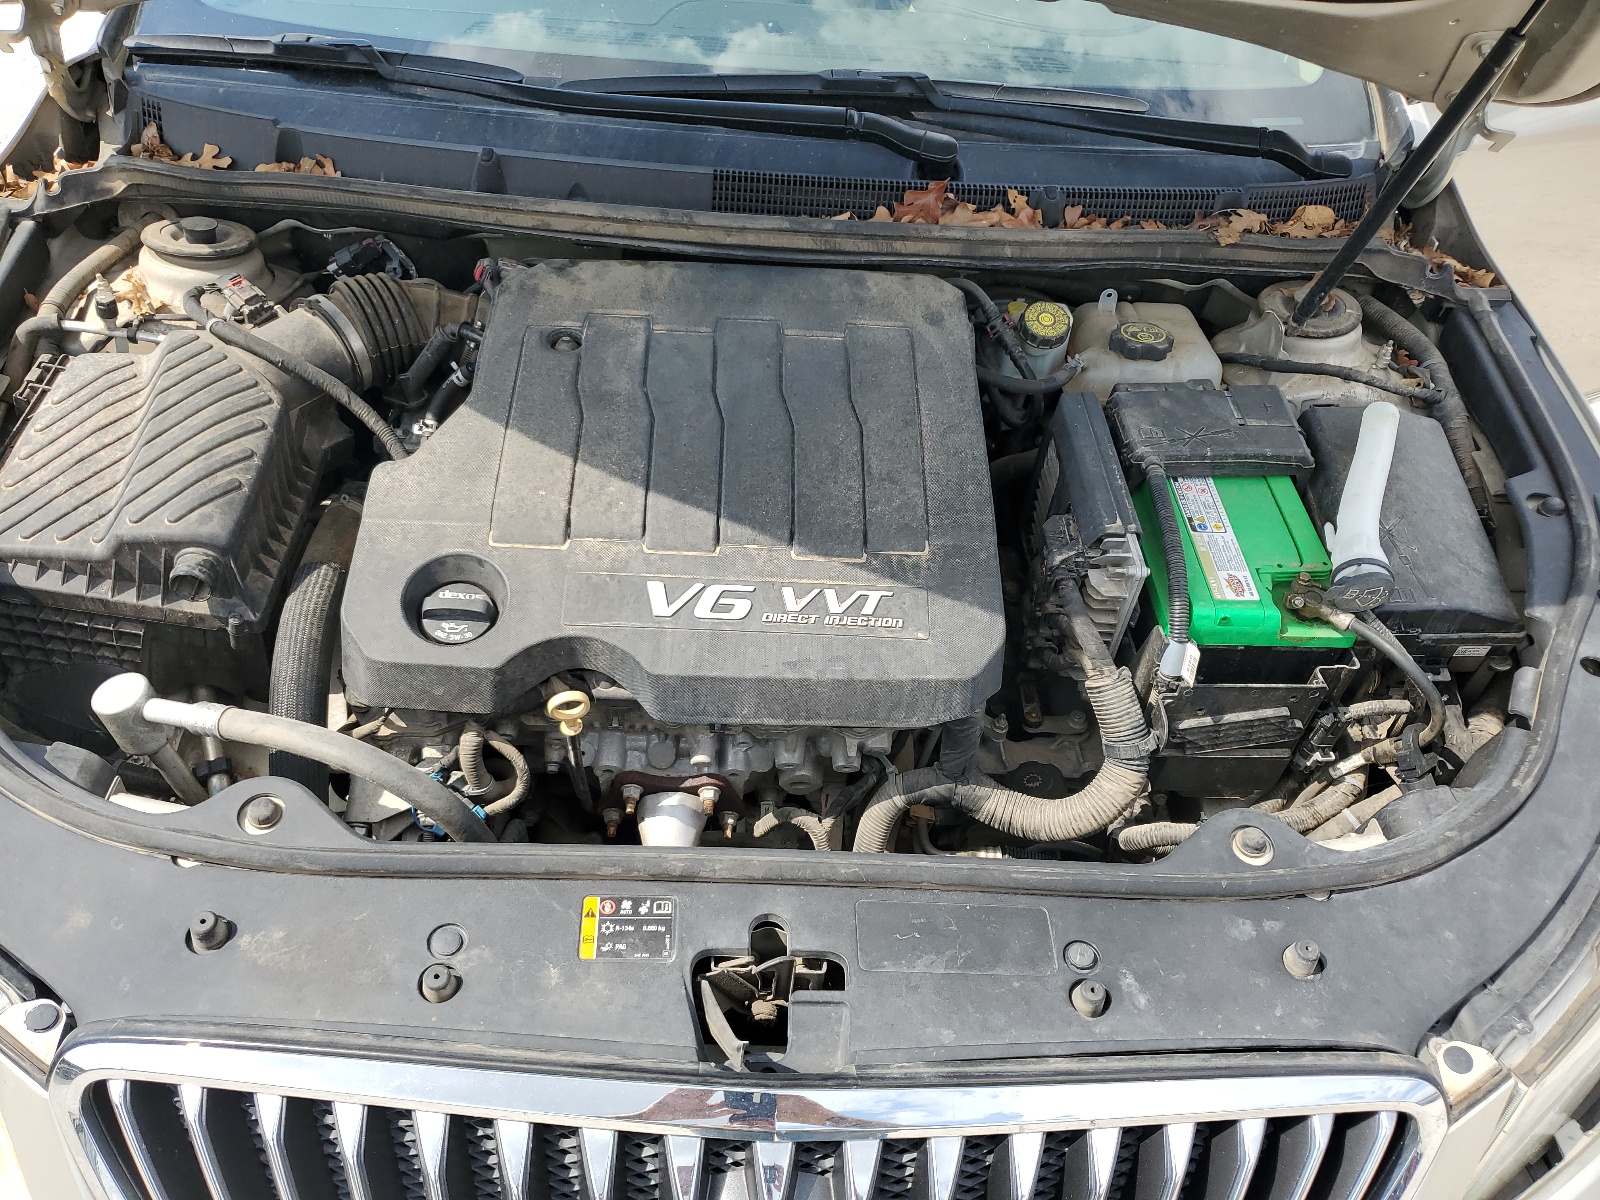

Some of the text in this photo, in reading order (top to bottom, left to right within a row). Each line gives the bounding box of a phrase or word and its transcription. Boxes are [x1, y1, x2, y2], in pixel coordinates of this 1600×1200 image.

[646, 580, 894, 620] V6 VVT
[761, 612, 904, 629] DIRECT INJECTION
[435, 630, 448, 639] SAE
